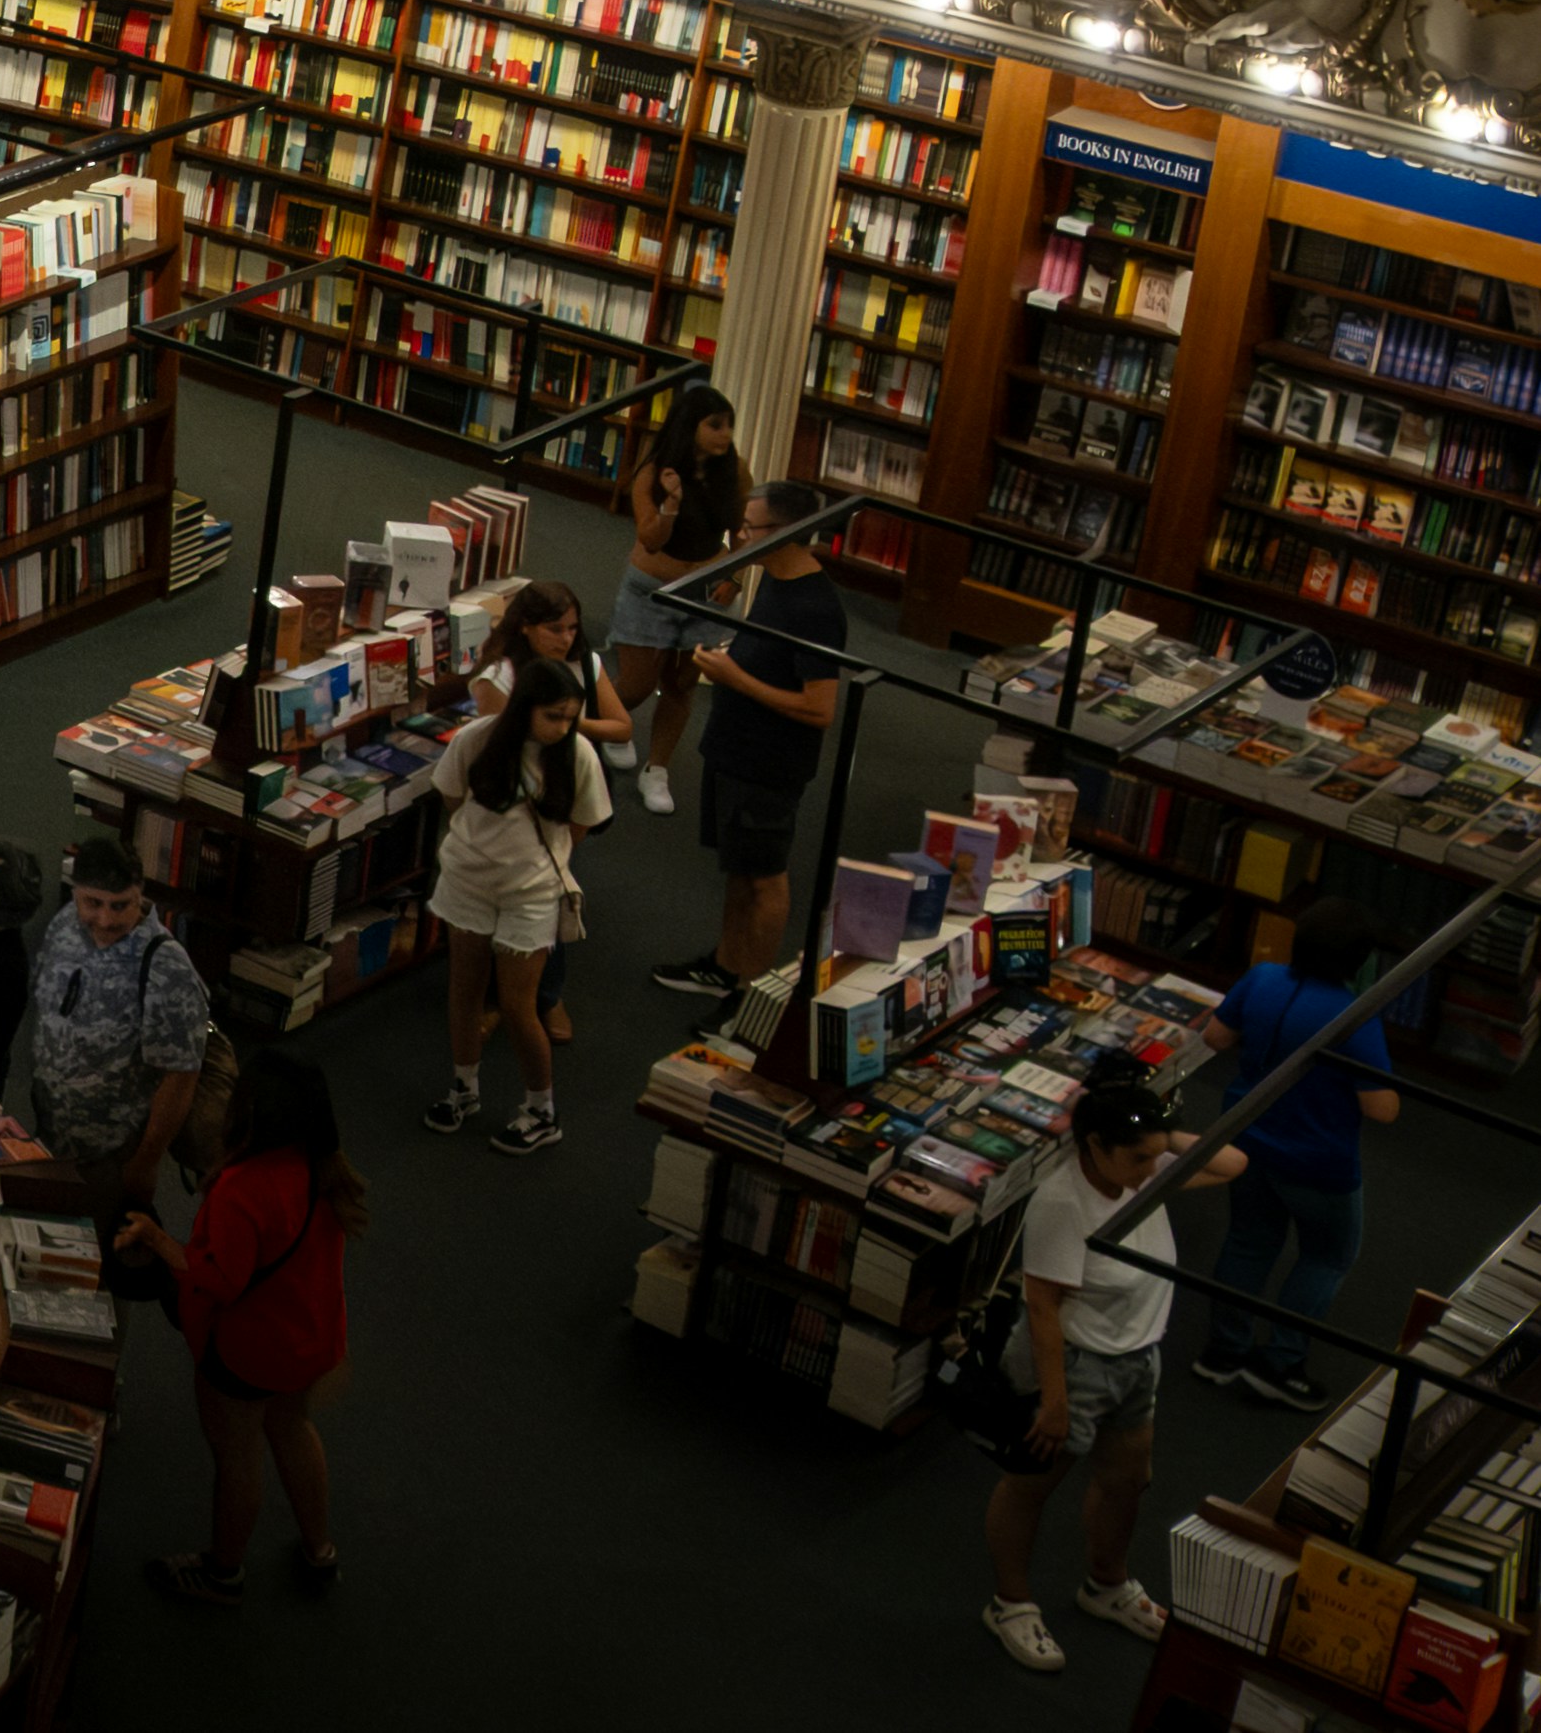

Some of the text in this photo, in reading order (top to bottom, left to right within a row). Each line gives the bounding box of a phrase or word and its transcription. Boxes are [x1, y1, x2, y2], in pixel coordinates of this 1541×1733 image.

[1057, 133, 1201, 183] BOOKS IN ENGLISH
